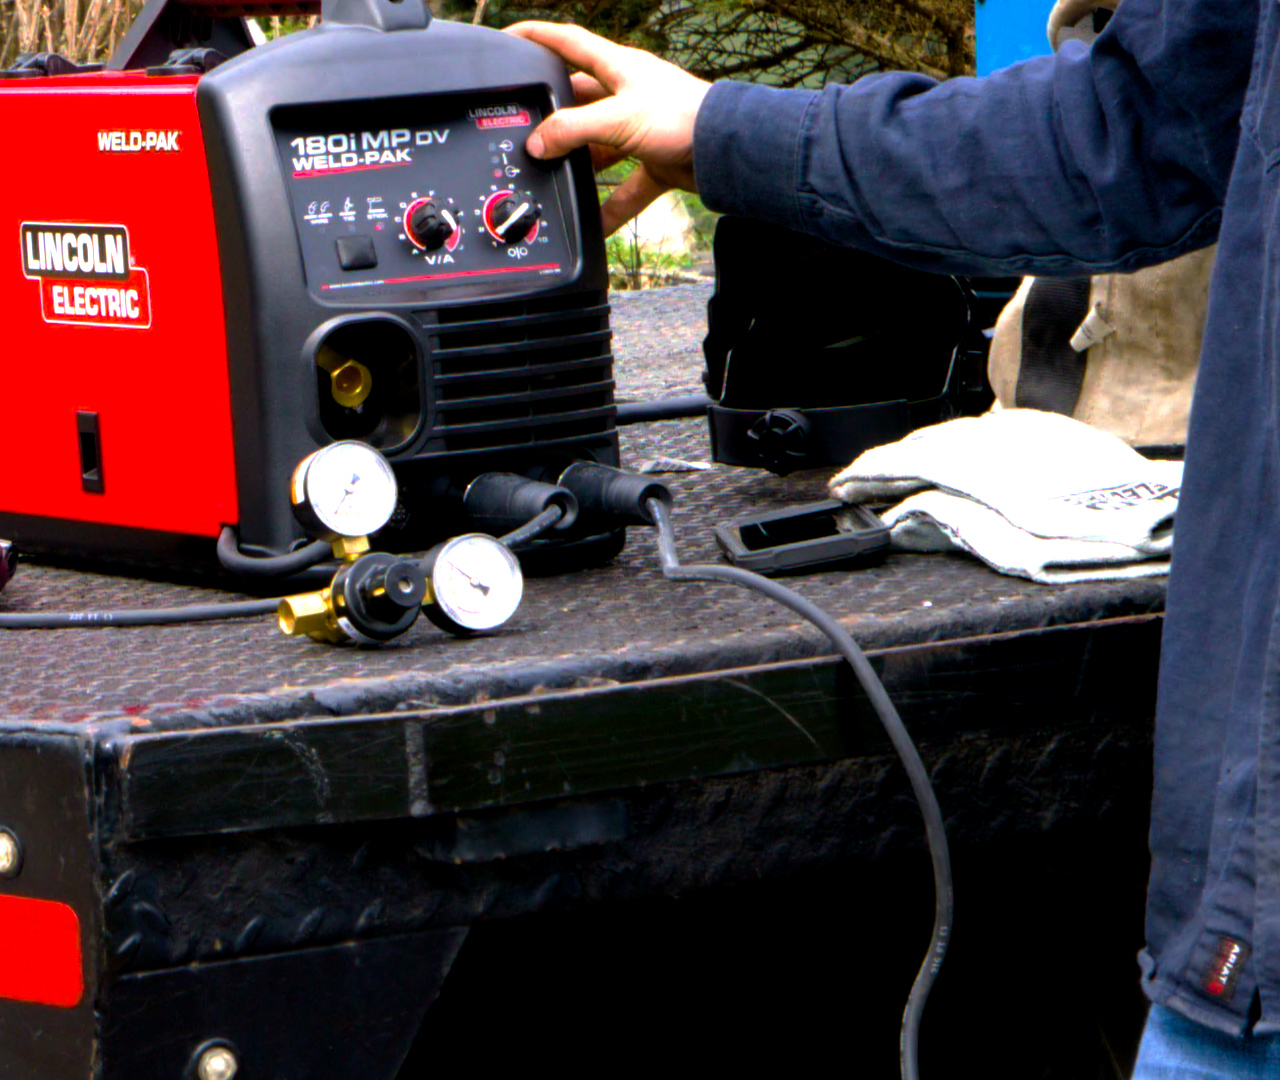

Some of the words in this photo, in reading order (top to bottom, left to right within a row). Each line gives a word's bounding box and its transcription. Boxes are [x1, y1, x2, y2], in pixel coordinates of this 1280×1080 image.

[469, 106, 517, 118] LINCOLN
[482, 116, 525, 127] ELECTRIC
[291, 135, 356, 156] 180i
[362, 129, 413, 149] MP
[415, 129, 451, 146] DV
[25, 232, 125, 274] LINCOLN
[51, 286, 140, 319] ELECTRIC
[1218, 943, 1241, 985] ARIAT
